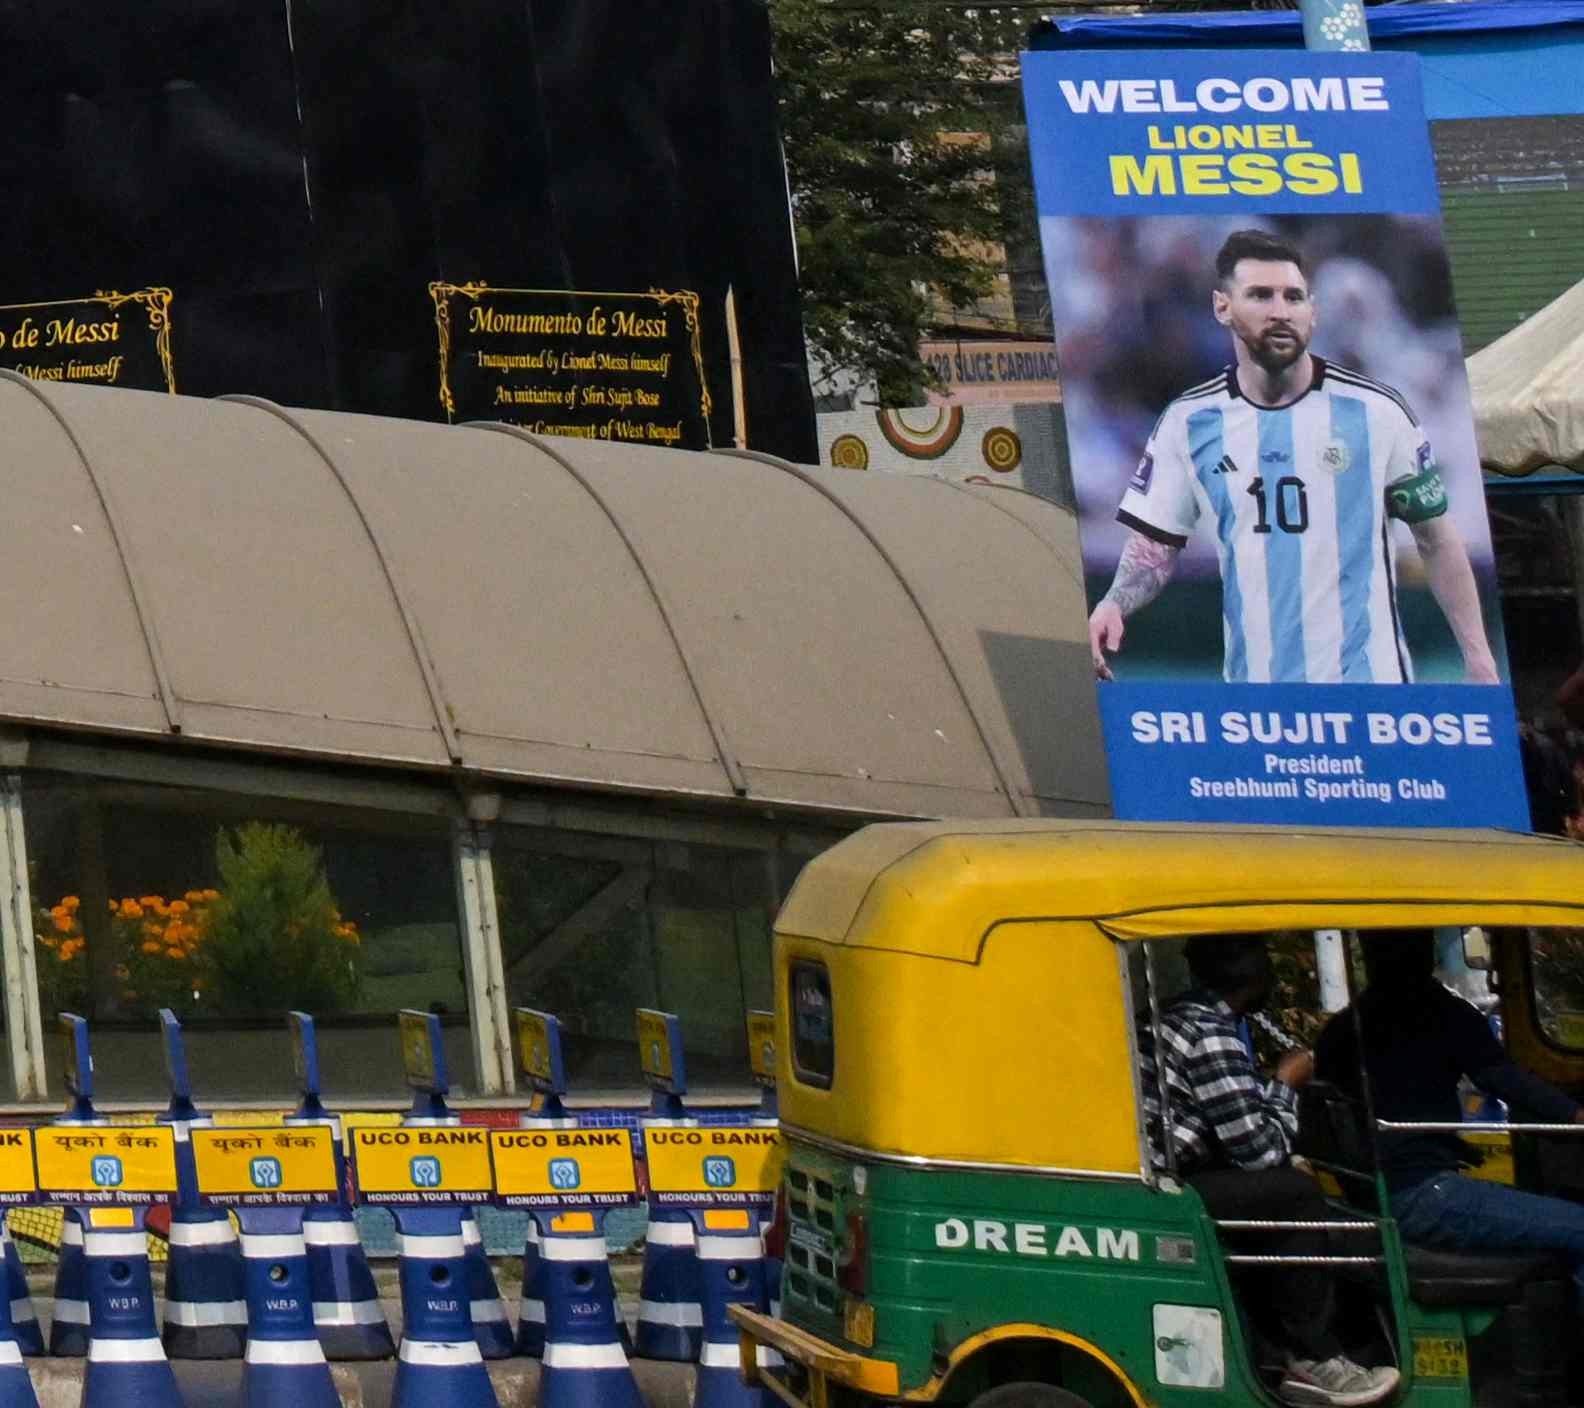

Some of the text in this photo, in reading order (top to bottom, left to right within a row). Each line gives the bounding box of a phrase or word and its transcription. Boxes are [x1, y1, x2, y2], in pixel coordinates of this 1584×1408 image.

[1058, 77, 1390, 113] WELCOME
[1147, 124, 1313, 150] LIONEL
[1109, 153, 1364, 195] MESSI
[12, 318, 39, 349] de
[46, 314, 120, 346] Messi
[469, 306, 668, 338] Monumento de Messi
[67, 356, 124, 383] himself
[478, 350, 672, 378] Inaugurated by Lionel Messi himself
[957, 351, 993, 383] SLICE
[494, 386, 661, 410] An initiative of Shri Sujit Bose
[599, 420, 614, 442] of
[617, 420, 644, 440] West
[648, 420, 683, 446] Bengal
[1247, 476, 1309, 534] 10
[1131, 712, 1493, 745] SRI SUJIT BOSE
[1264, 753, 1364, 775] President
[1190, 776, 1446, 803] Sreebhumi Sporting Club
[211, 1133, 317, 1154] यूको बैंक
[935, 1218, 1140, 1261] DREAM
